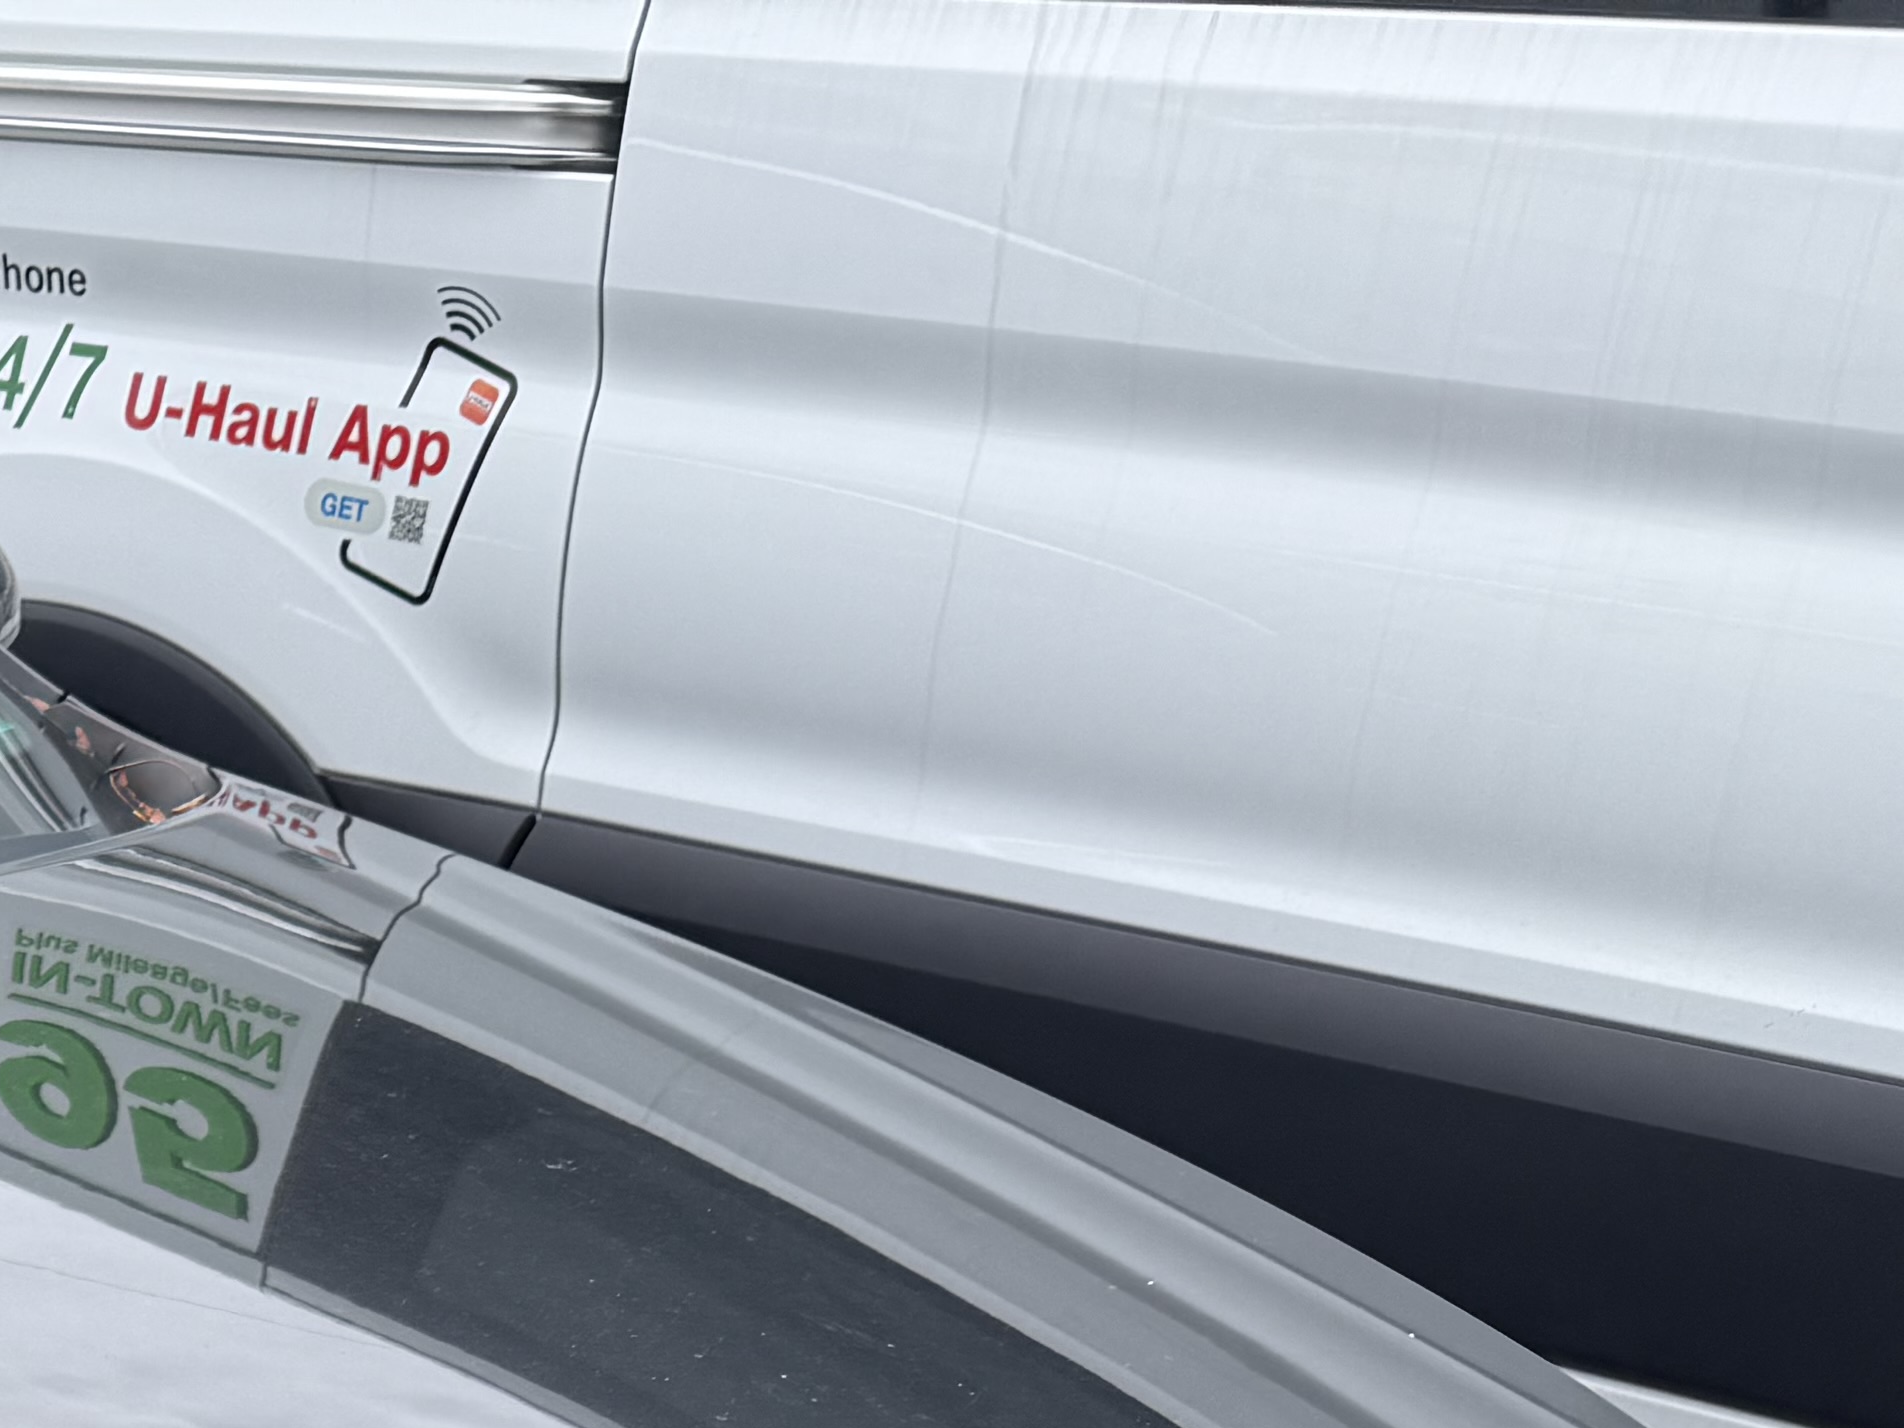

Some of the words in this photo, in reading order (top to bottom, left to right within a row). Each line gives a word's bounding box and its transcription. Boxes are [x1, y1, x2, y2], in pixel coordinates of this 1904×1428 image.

[124, 372, 319, 455] U-Haul
[328, 404, 451, 487] App
[320, 493, 369, 522] GET
